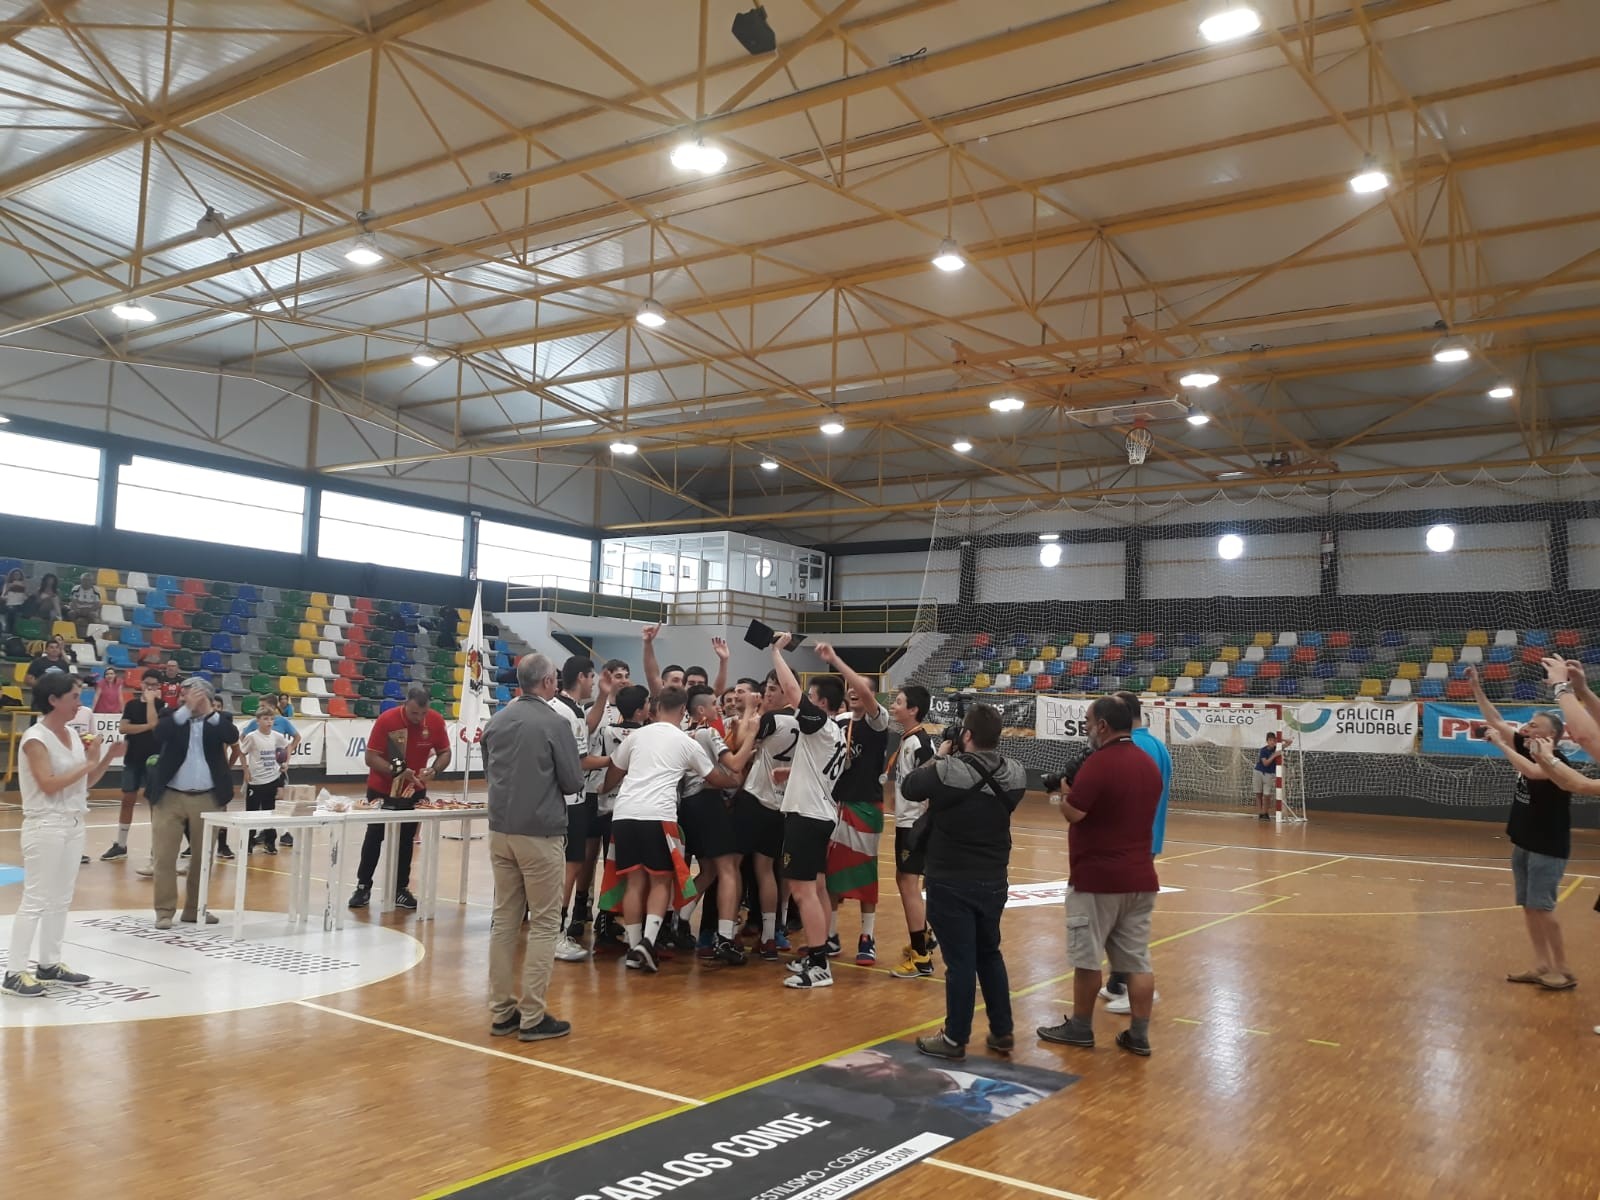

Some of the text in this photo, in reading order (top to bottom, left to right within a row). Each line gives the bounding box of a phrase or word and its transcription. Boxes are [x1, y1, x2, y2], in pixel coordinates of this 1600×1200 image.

[1205, 714, 1254, 725] GALEGO
[1336, 707, 1394, 721] GALICIA
[1336, 721, 1412, 735] SAUDABLE
[574, 1112, 832, 1200] ARLOS CONDE
[827, 1147, 877, 1169] CORTE
